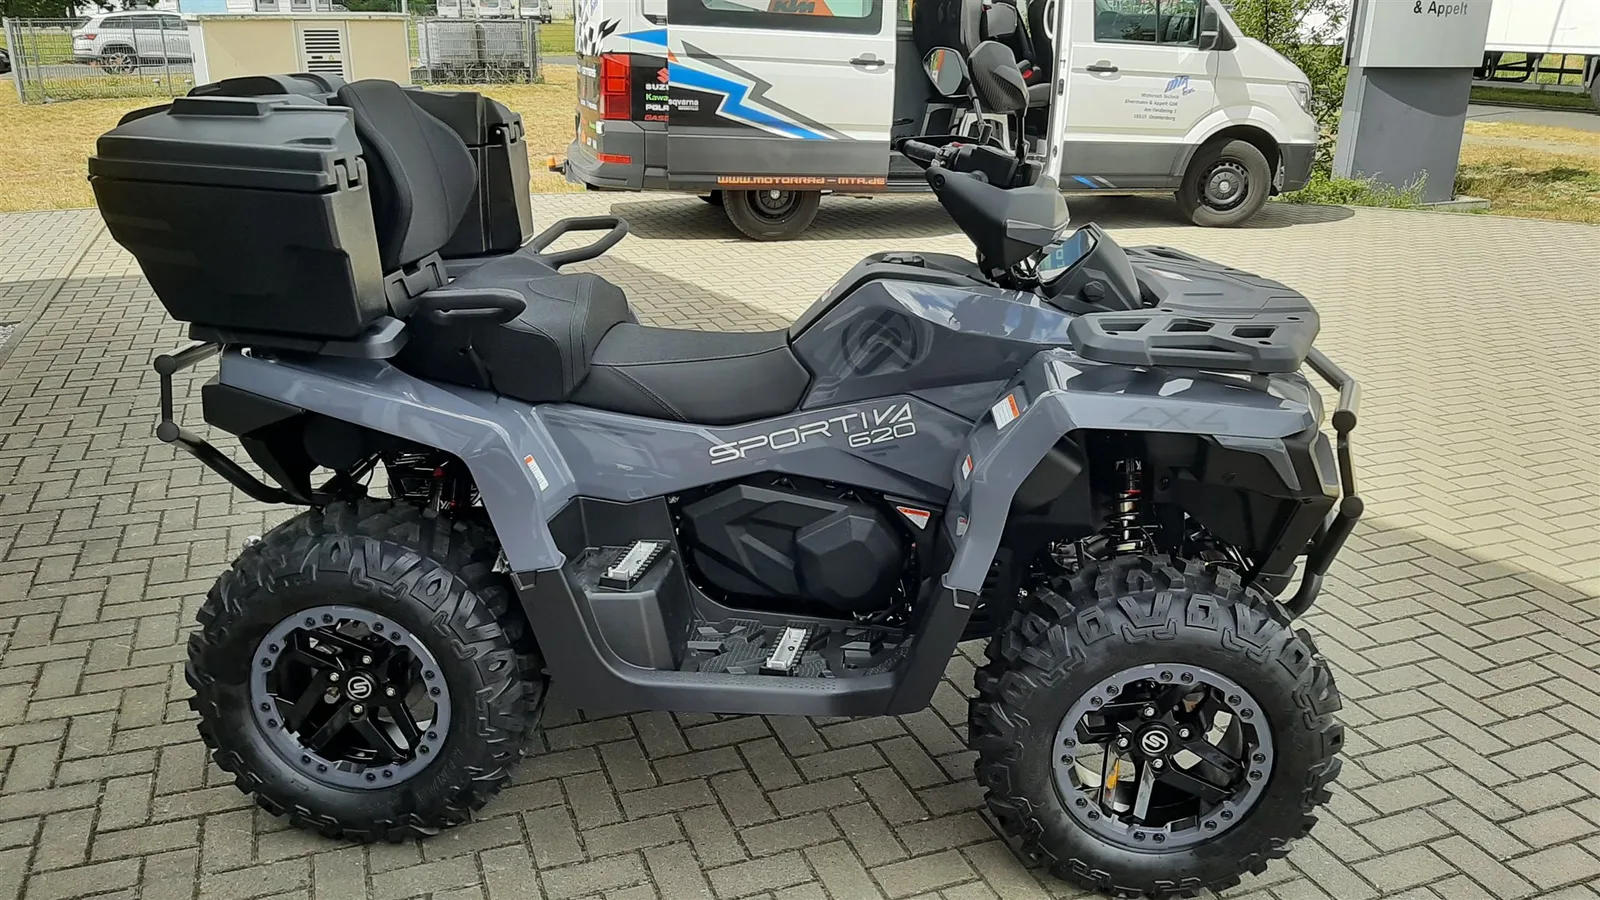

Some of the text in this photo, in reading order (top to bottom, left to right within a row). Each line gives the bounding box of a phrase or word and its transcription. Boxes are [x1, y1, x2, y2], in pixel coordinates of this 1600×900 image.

[1413, 0, 1468, 17] & Appelt
[708, 402, 913, 465] SPORTIVA
[847, 421, 917, 448] 620
